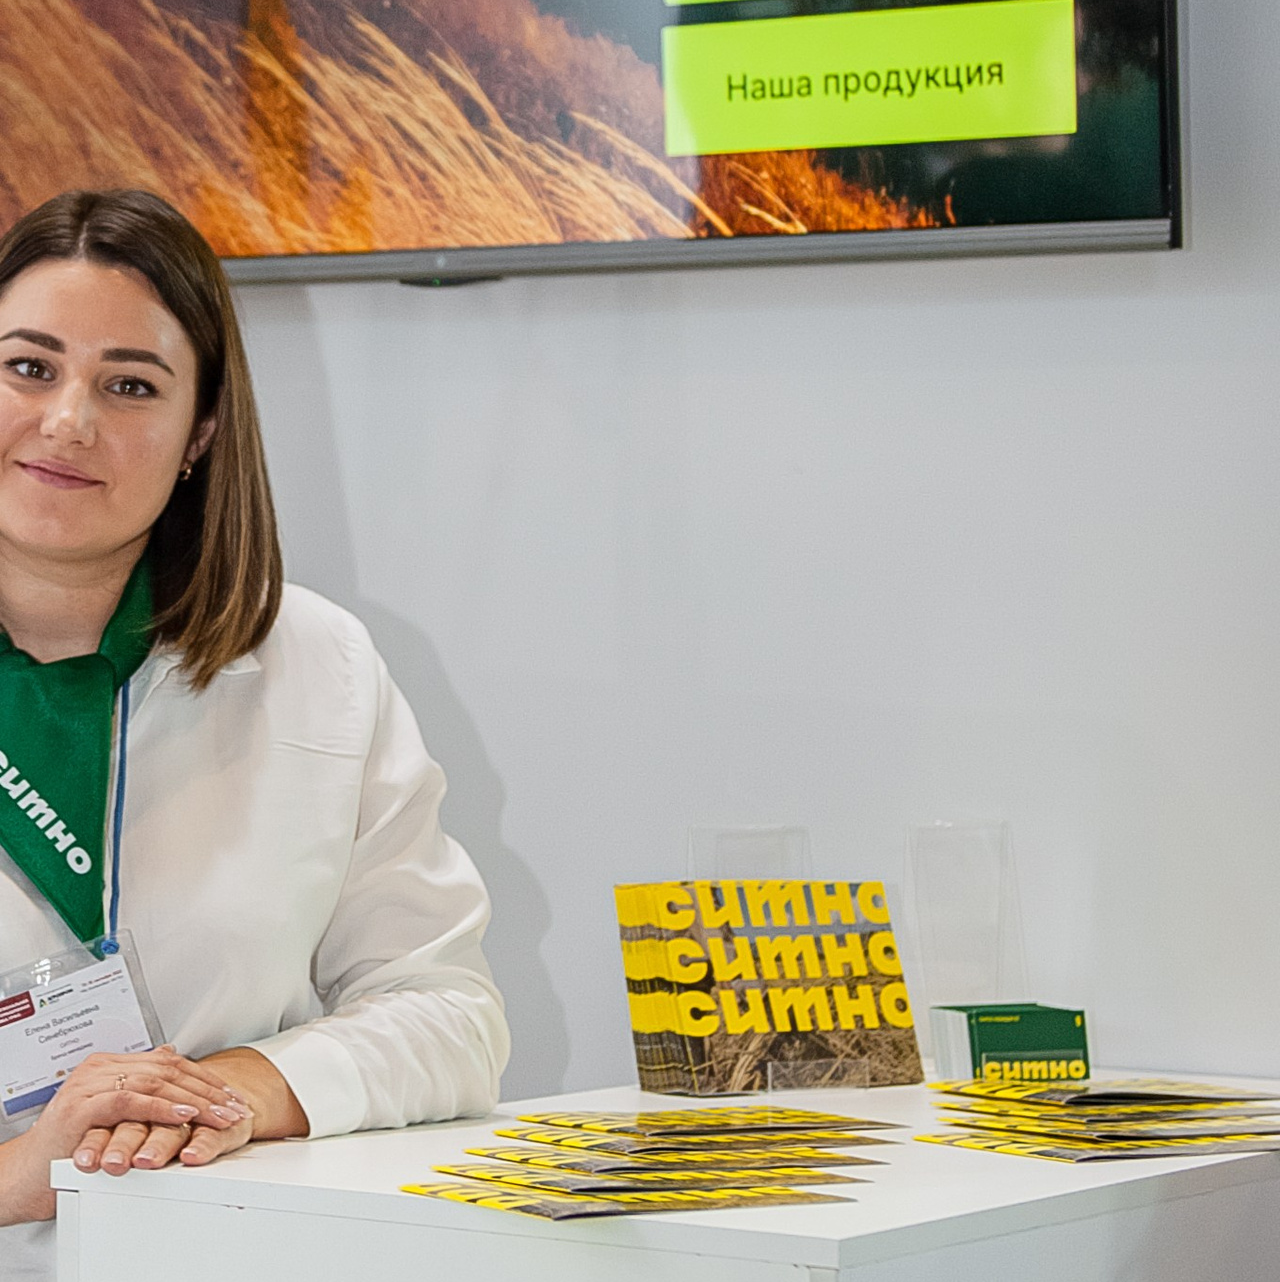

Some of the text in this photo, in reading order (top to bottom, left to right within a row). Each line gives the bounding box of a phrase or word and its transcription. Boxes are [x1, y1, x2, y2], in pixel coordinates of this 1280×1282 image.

[726, 61, 1004, 103] Наша продукция
[660, 881, 890, 930] ситно
[666, 930, 904, 984] ситно
[676, 982, 915, 1037] ситно
